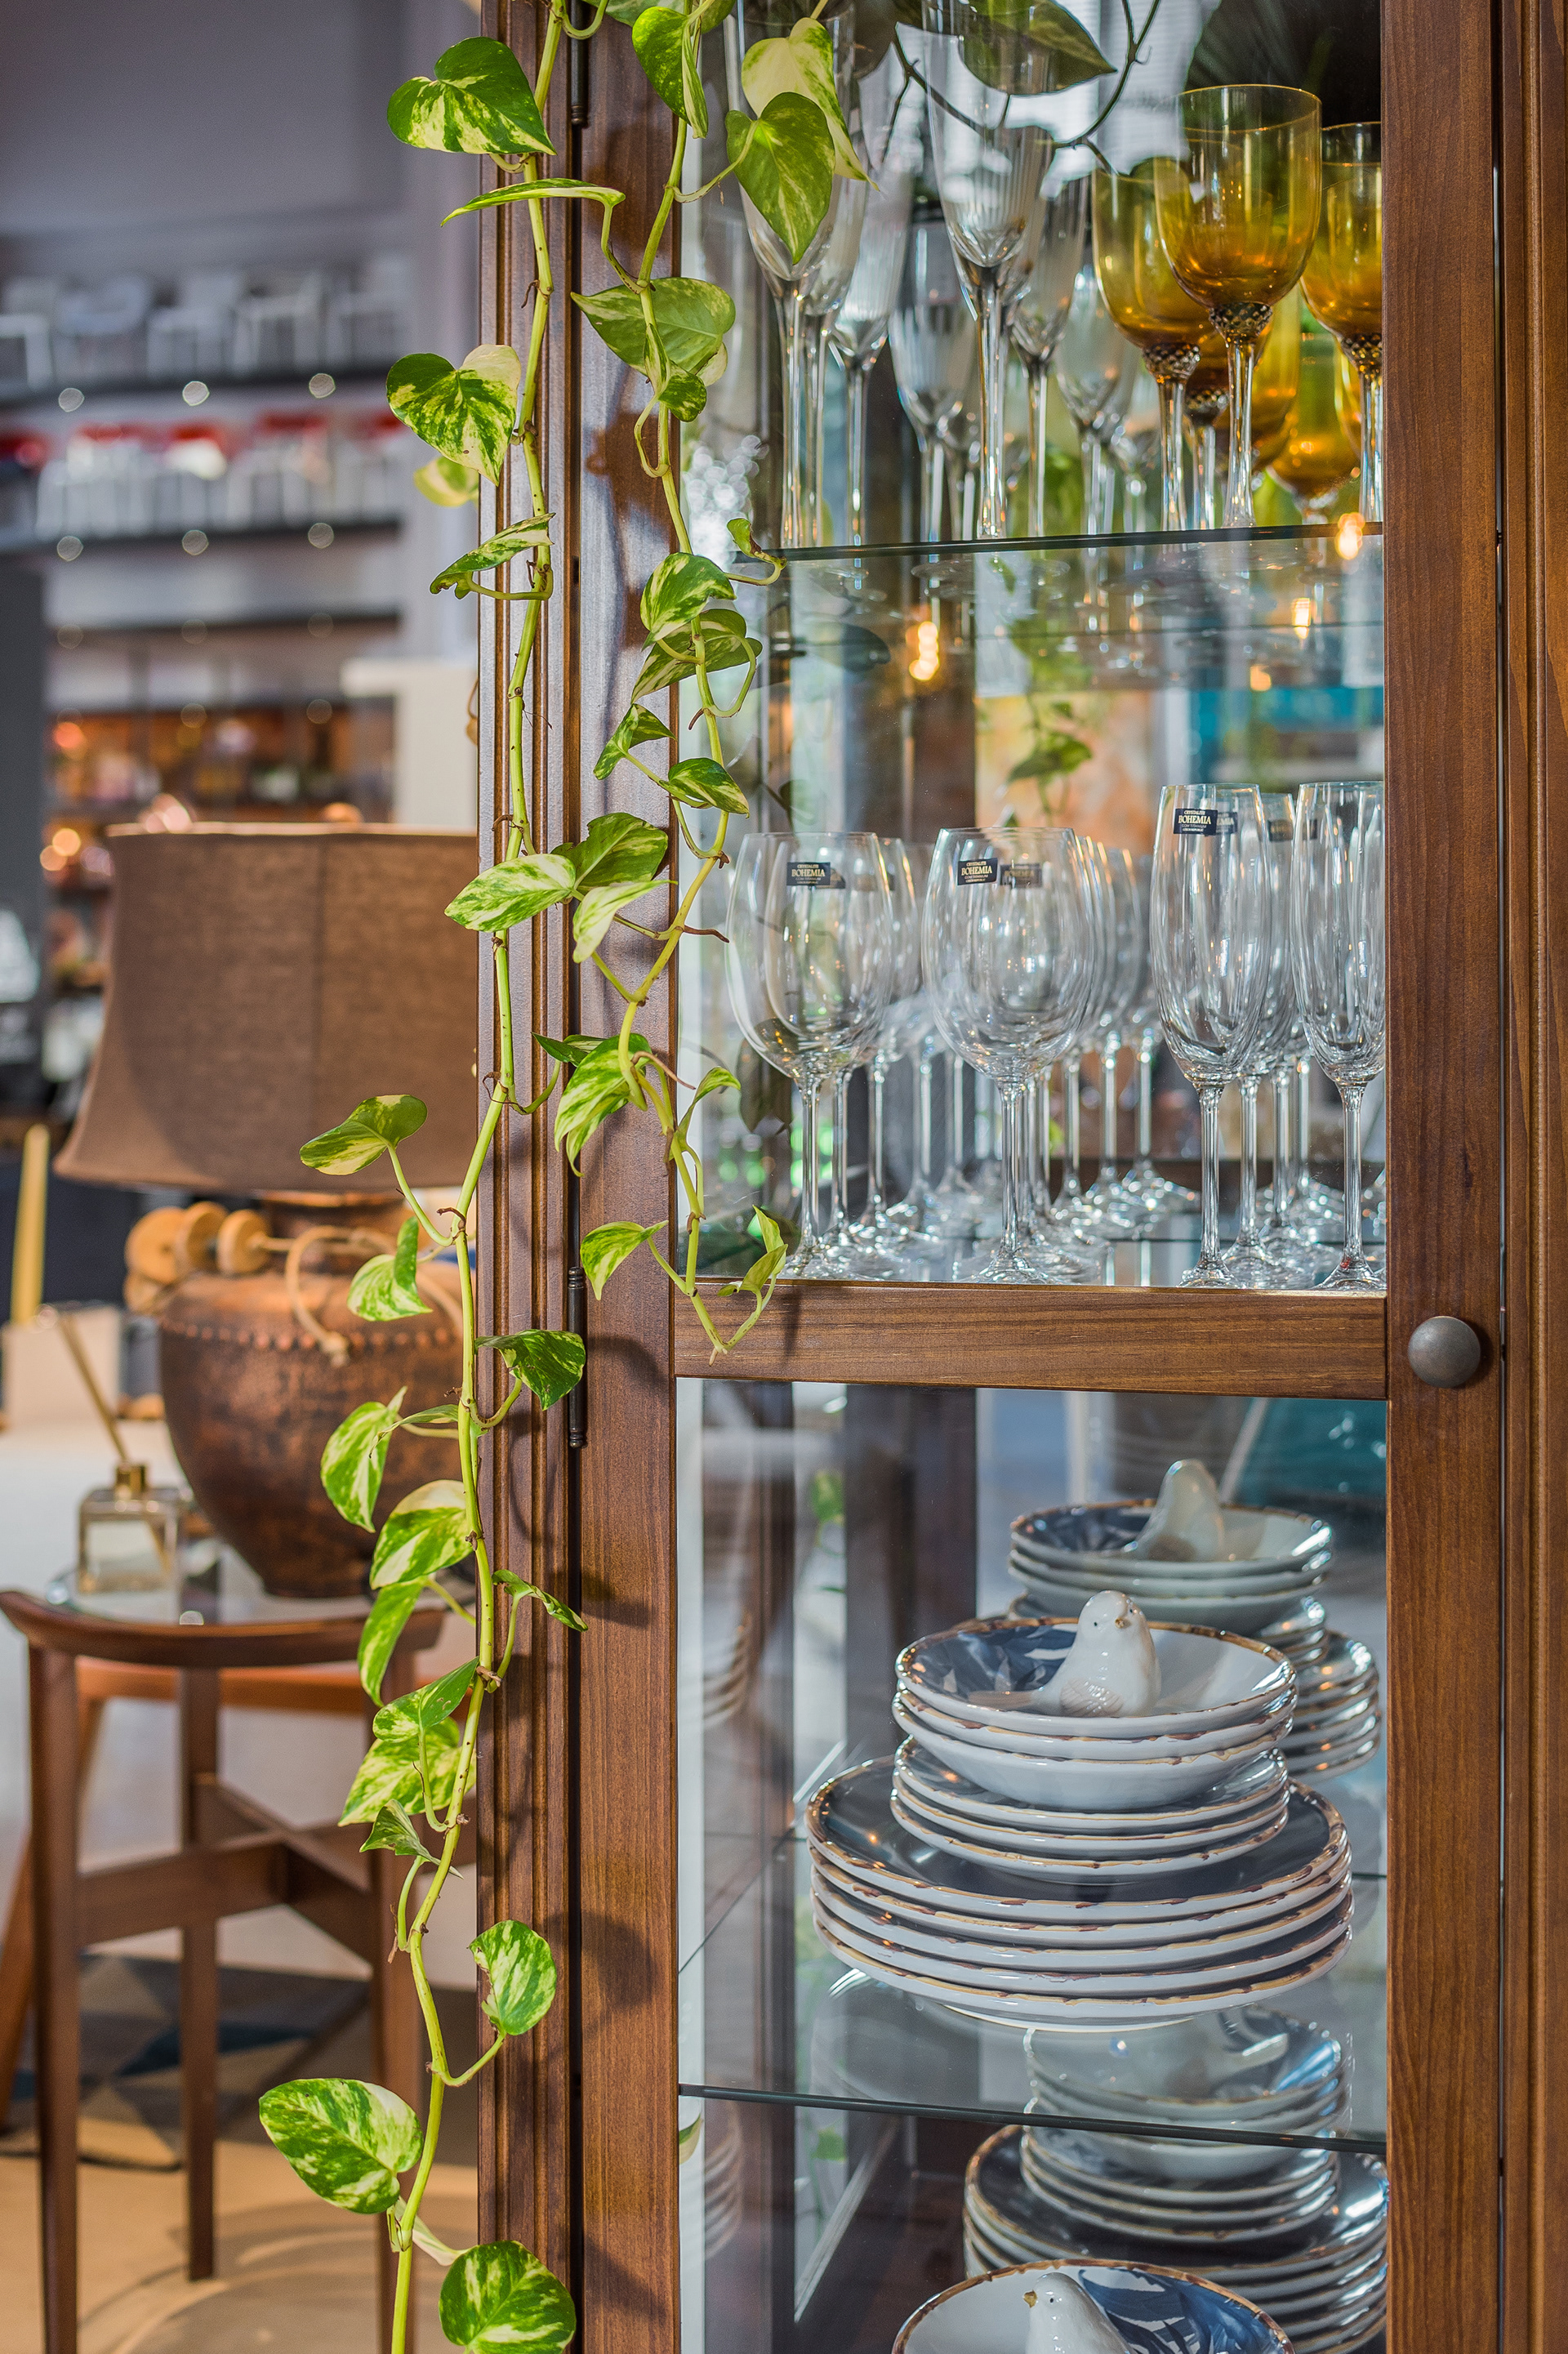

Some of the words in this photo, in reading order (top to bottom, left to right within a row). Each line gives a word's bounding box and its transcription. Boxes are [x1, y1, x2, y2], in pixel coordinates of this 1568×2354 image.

[1178, 815, 1211, 824] BOHEMIA
[791, 868, 825, 876] BOHEMIA
[961, 866, 992, 876] BOHEMIA
